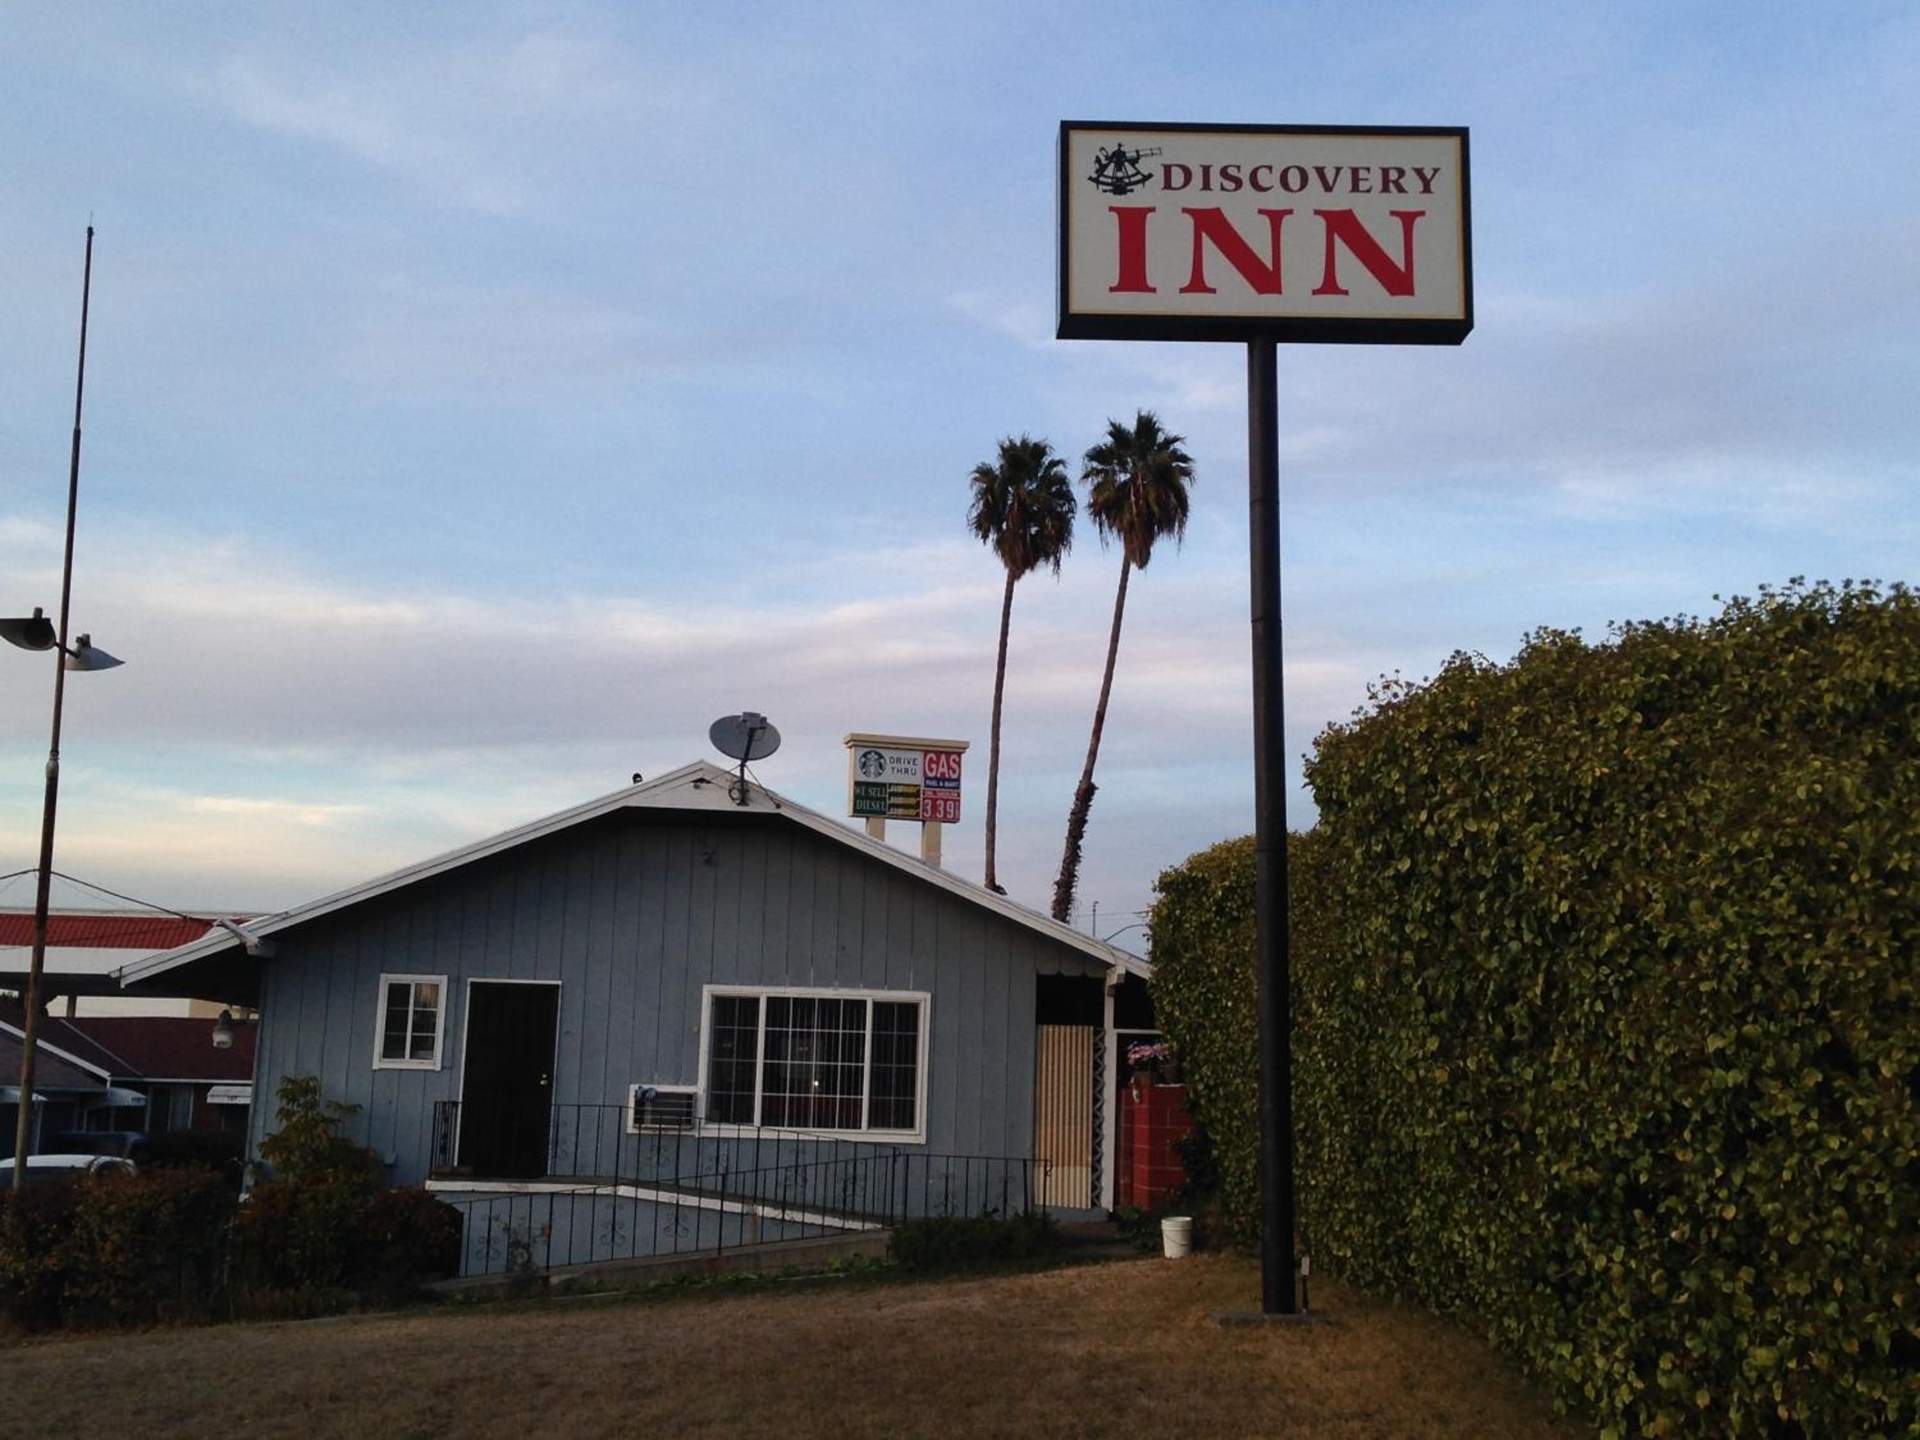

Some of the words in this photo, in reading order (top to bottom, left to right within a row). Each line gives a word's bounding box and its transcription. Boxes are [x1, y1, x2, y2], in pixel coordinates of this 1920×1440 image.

[1161, 163, 1441, 194] DISCOVERY
[1109, 206, 1426, 296] INN
[889, 756, 918, 766] DRIVE
[891, 767, 917, 776] THRU
[925, 753, 959, 778] GAS
